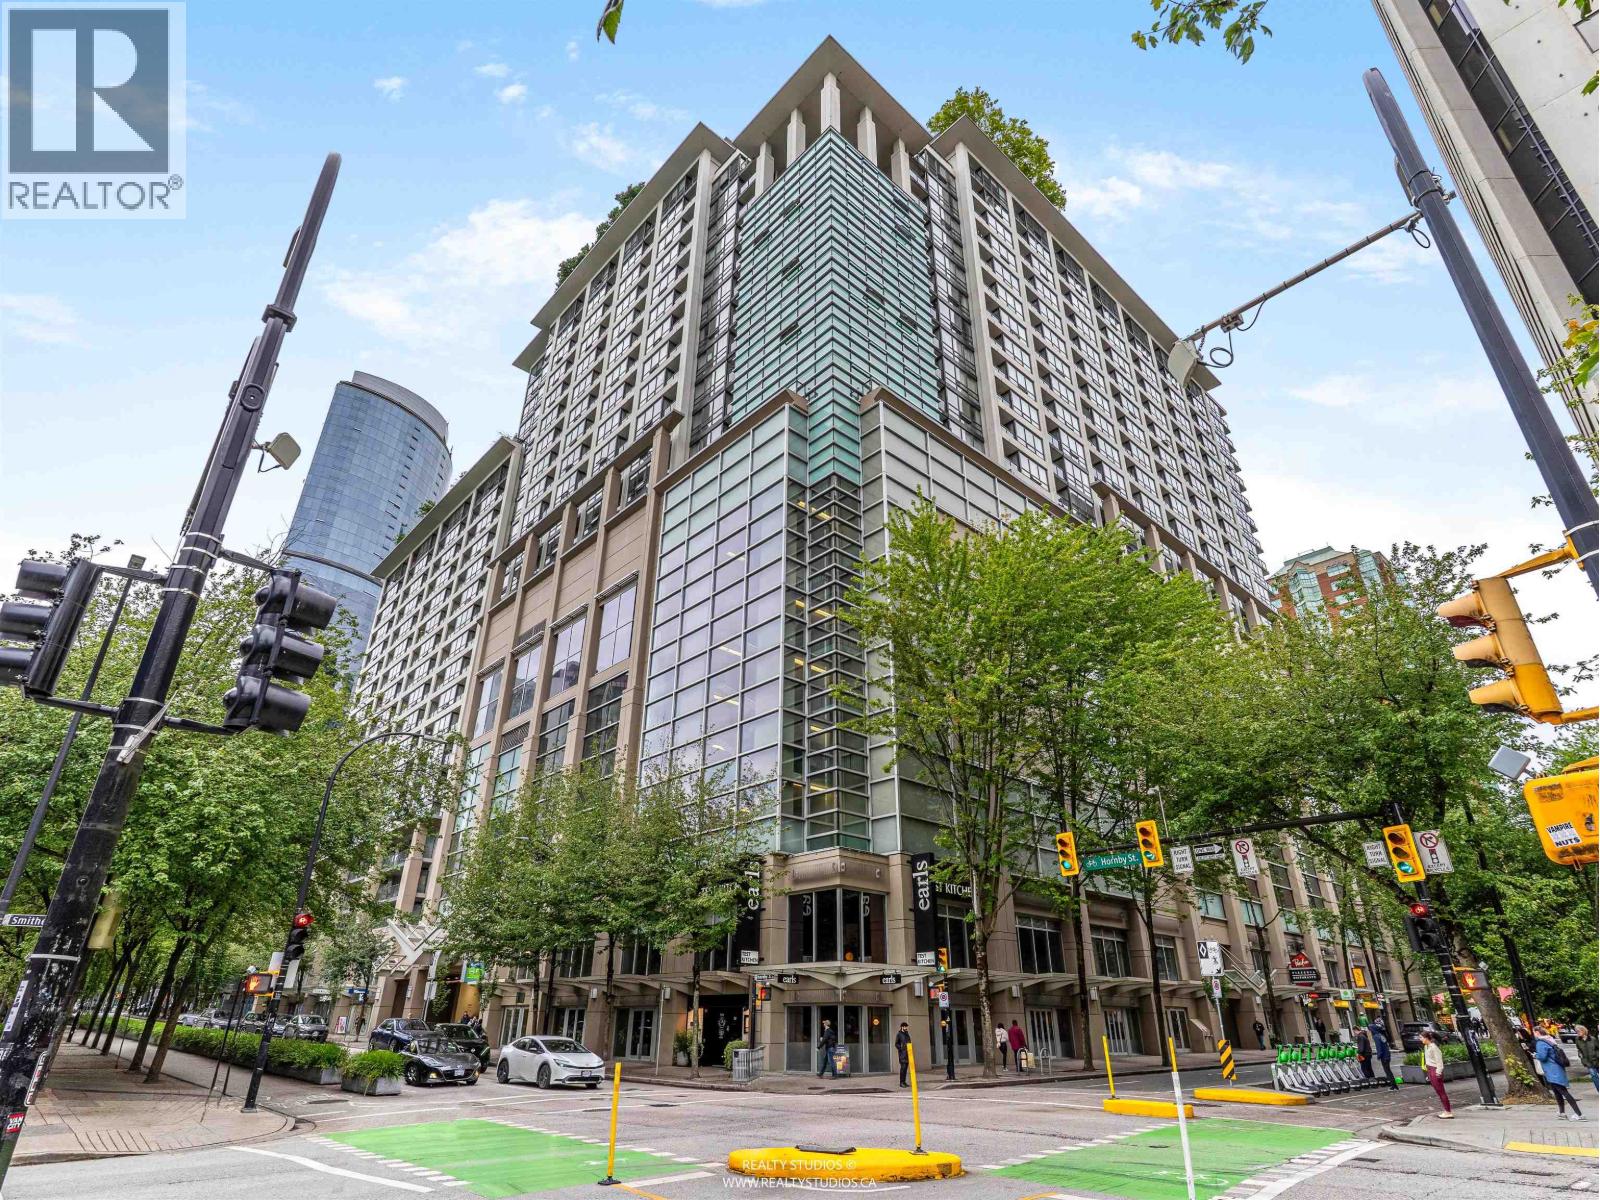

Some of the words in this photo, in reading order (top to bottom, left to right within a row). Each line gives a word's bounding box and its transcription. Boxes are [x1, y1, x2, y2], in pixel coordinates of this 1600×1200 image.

[1546, 822, 1574, 834] VAMPIRE
[1555, 837, 1581, 847] NUTS
[1173, 848, 1187, 856] RIGHT
[1101, 856, 1127, 866] Hornby
[1128, 854, 1139, 862] St.
[912, 860, 930, 911] earls
[945, 883, 972, 897] KITCHE
[782, 975, 797, 984] earls
[882, 975, 896, 984] earls
[9, 1116, 24, 1124] VAN
[6, 1122, 21, 1130] CITY
